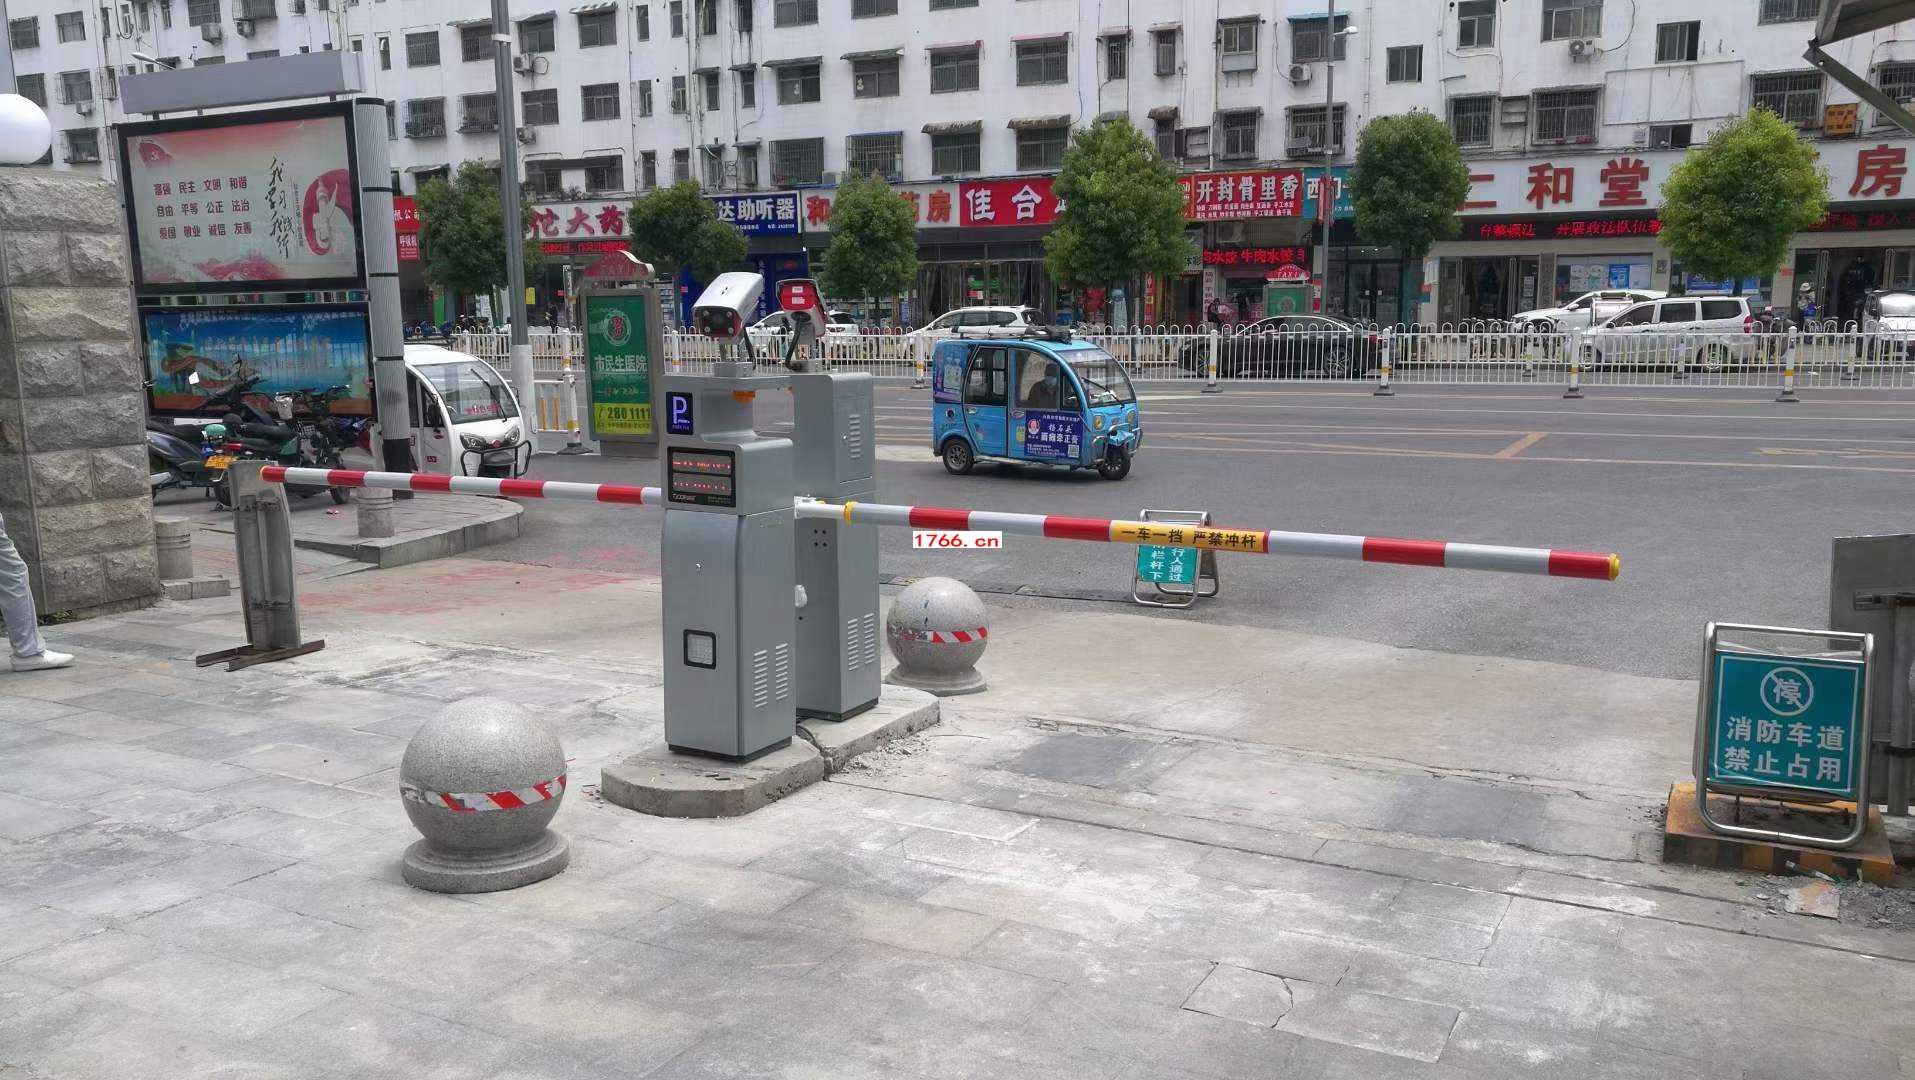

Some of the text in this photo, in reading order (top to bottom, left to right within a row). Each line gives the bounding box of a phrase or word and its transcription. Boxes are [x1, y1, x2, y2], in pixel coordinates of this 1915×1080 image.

[1848, 144, 1908, 197] 房
[153, 176, 248, 196] 富强 民主 文明 和谐
[1197, 175, 1299, 203] 开封骨里香
[156, 199, 250, 217] 自由 平等 公正 法治
[159, 221, 252, 240] 爱国 敬业 诚信 友善
[594, 355, 648, 372] 市民生医院
[1192, 530, 1257, 549] 严禁冲杆
[1772, 678, 1802, 705] 停
[1726, 715, 1845, 751] 消防车道
[1724, 746, 1841, 782] 禁止占用
